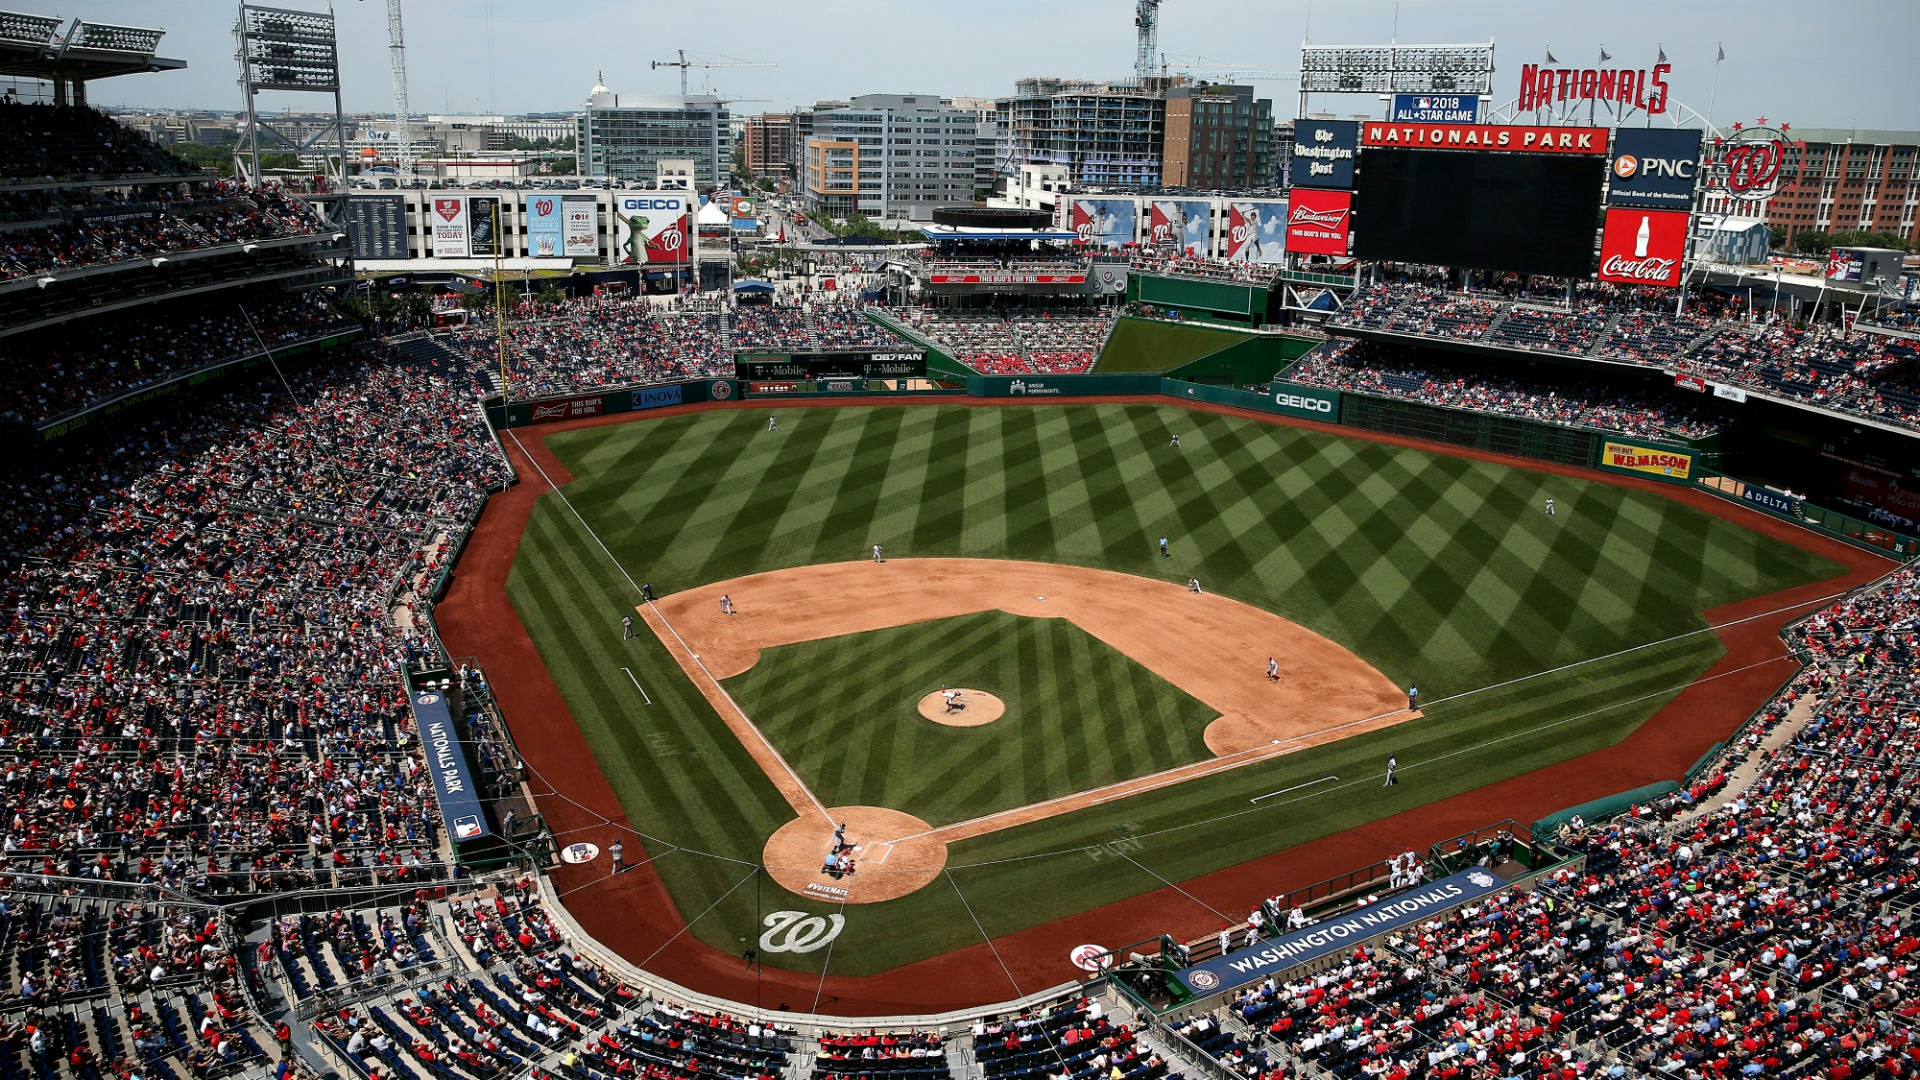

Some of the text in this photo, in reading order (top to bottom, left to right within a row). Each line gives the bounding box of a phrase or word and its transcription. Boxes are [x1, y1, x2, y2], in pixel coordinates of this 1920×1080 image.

[1518, 64, 1671, 114] NATIONALS
[1432, 97, 1459, 109] 2018
[1397, 109, 1473, 121] ALL STAR GAME
[1315, 129, 1333, 143] The
[1371, 127, 1593, 149] NATIONALS PARK
[1294, 142, 1352, 160] Washington
[1310, 161, 1333, 176] Post
[1641, 157, 1693, 179] PNC
[1725, 139, 1785, 191] W
[624, 199, 680, 210] GEICO
[1293, 208, 1341, 223] Budweiser
[1330, 232, 1343, 240] YOU.
[1602, 254, 1677, 281] Coca-Cola
[898, 353, 922, 361] FAN
[571, 398, 602, 408] THIS BUD'S
[645, 390, 681, 404] INOVA
[1275, 392, 1332, 413] GEICO
[572, 406, 597, 416] FOR YOU.
[1755, 492, 1789, 511] DELTA
[427, 721, 464, 795] NATIONALS PARK
[759, 910, 846, 954] W
[1228, 883, 1464, 974] WASHINGTON NATIONALS
